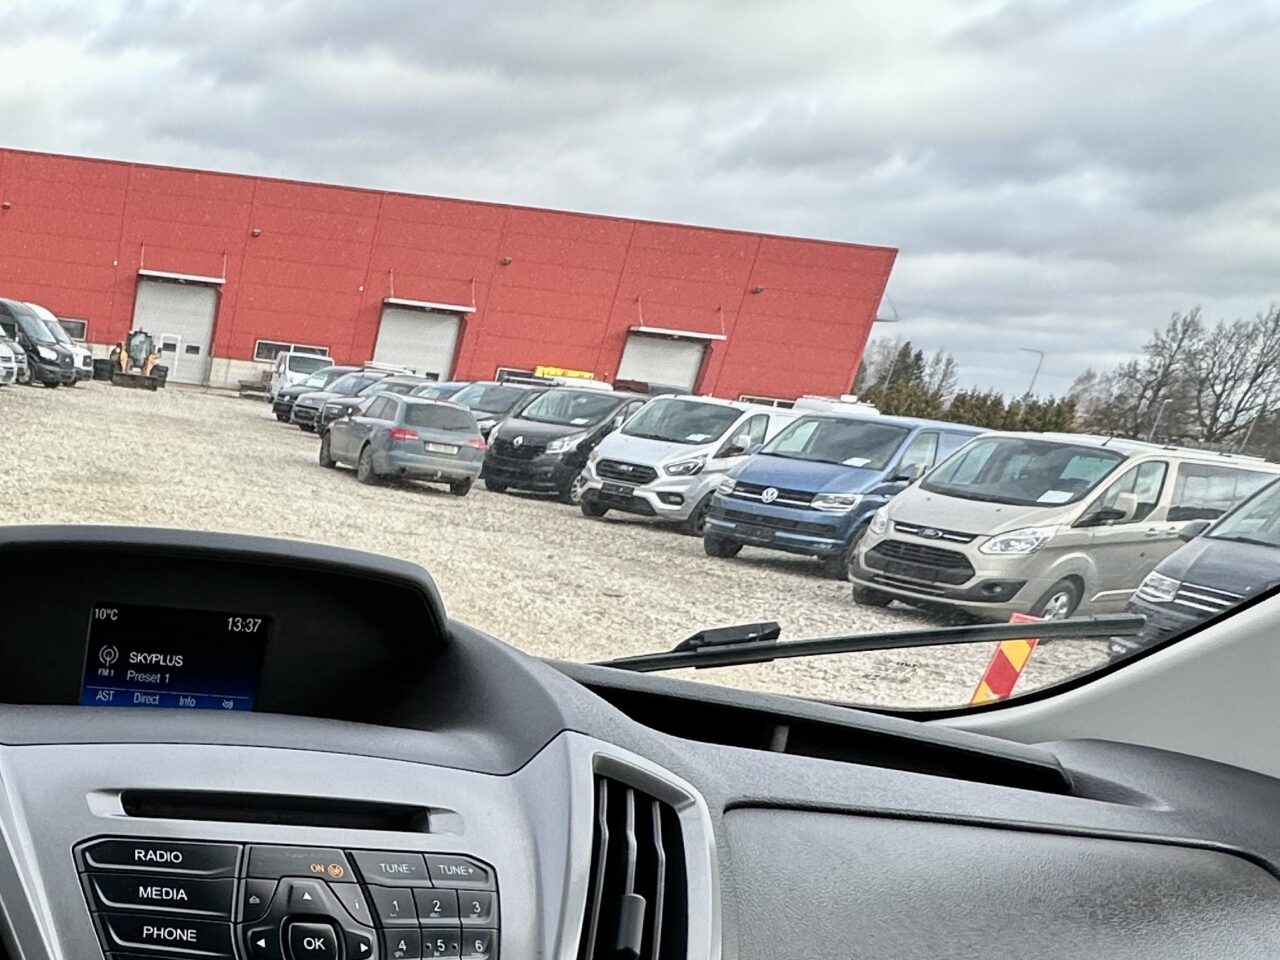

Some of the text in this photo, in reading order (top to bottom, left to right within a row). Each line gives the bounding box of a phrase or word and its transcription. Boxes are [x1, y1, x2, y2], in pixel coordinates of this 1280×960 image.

[94, 608, 118, 621] 10°C
[226, 617, 262, 633] 13:37
[129, 651, 184, 667] SKYPLUS
[126, 670, 170, 684] Preset 1
[96, 690, 116, 702] AST
[133, 692, 160, 705] Direct
[179, 695, 197, 708] Info
[134, 849, 183, 864] RADIO
[310, 863, 325, 873] ON
[138, 886, 188, 901] MEDIA
[392, 900, 400, 912] 1
[432, 900, 442, 912] 2
[472, 901, 481, 913] 3
[142, 925, 198, 942] PHONE
[303, 937, 326, 950] OK
[398, 940, 407, 951] 4
[437, 939, 446, 951] 5
[475, 940, 484, 952] 6
